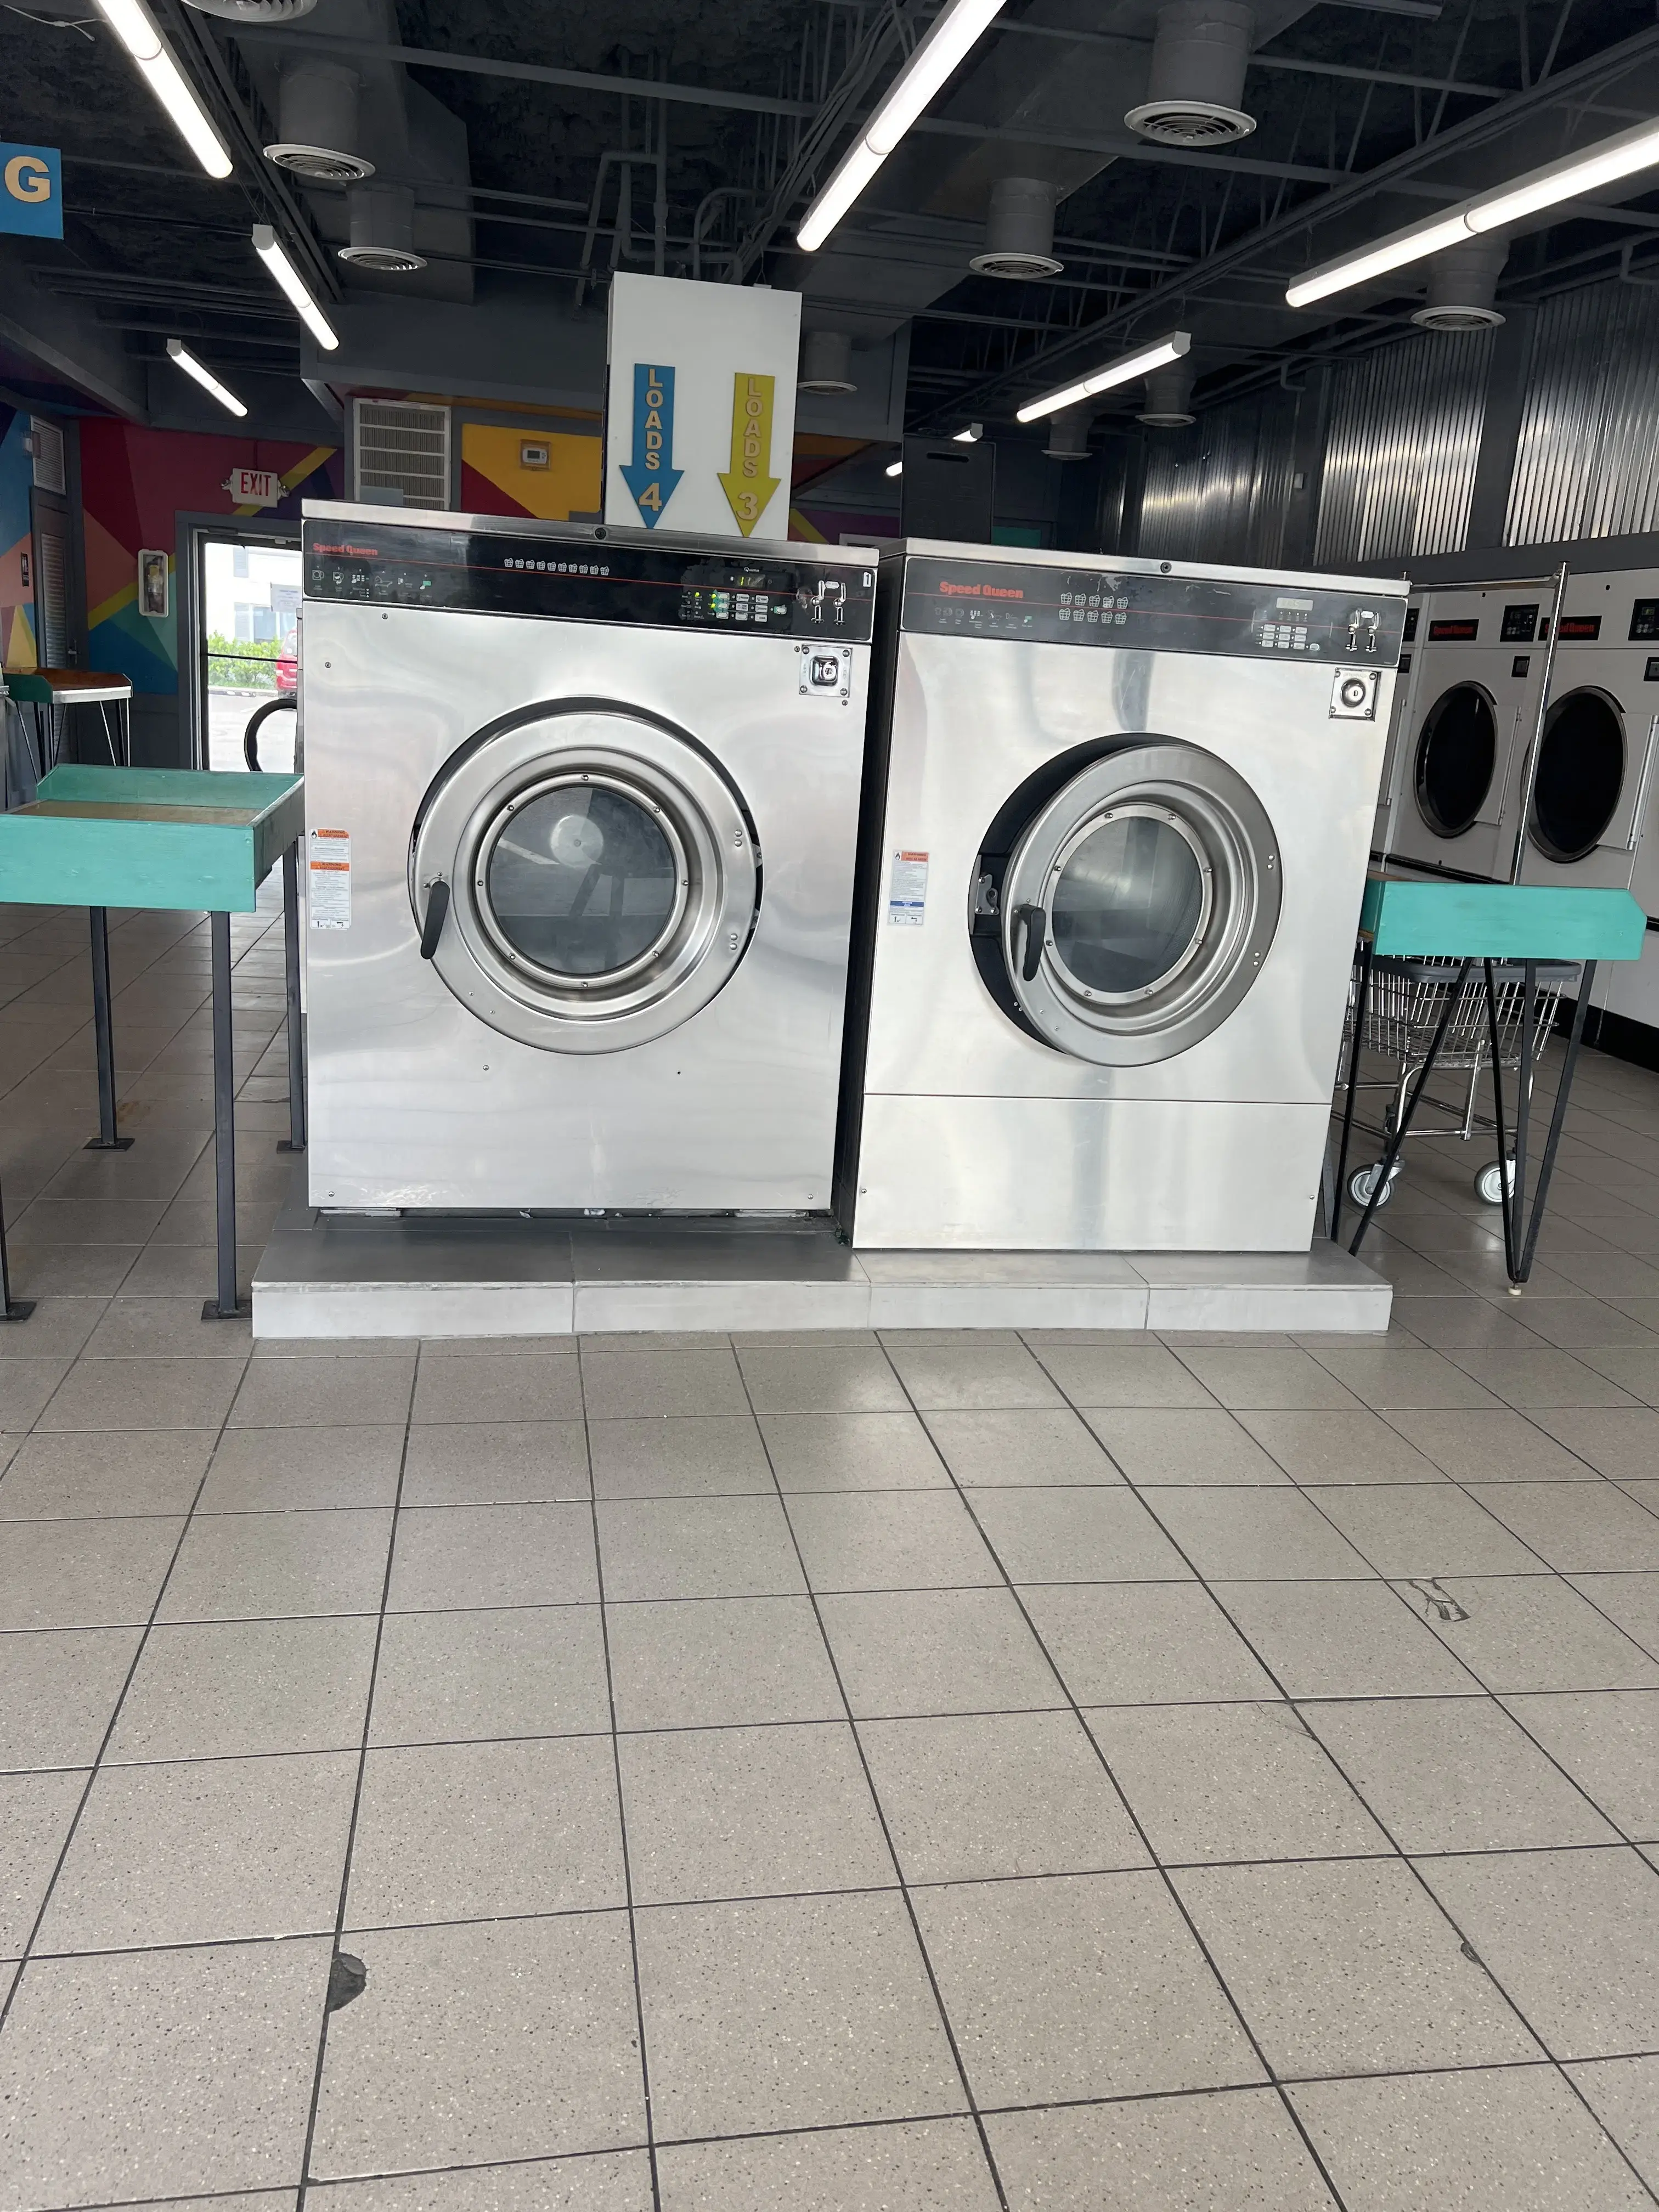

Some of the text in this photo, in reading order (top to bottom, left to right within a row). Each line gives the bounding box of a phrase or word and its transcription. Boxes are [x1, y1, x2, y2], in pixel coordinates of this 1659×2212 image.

[4, 155, 50, 203] G
[644, 368, 663, 471] LOADS
[742, 376, 763, 478] LOADS
[241, 472, 271, 496] EXIT
[638, 482, 663, 512] 4
[735, 492, 759, 521] 3
[313, 543, 378, 555] Speed Queen
[939, 581, 1024, 598] Speed Queen
